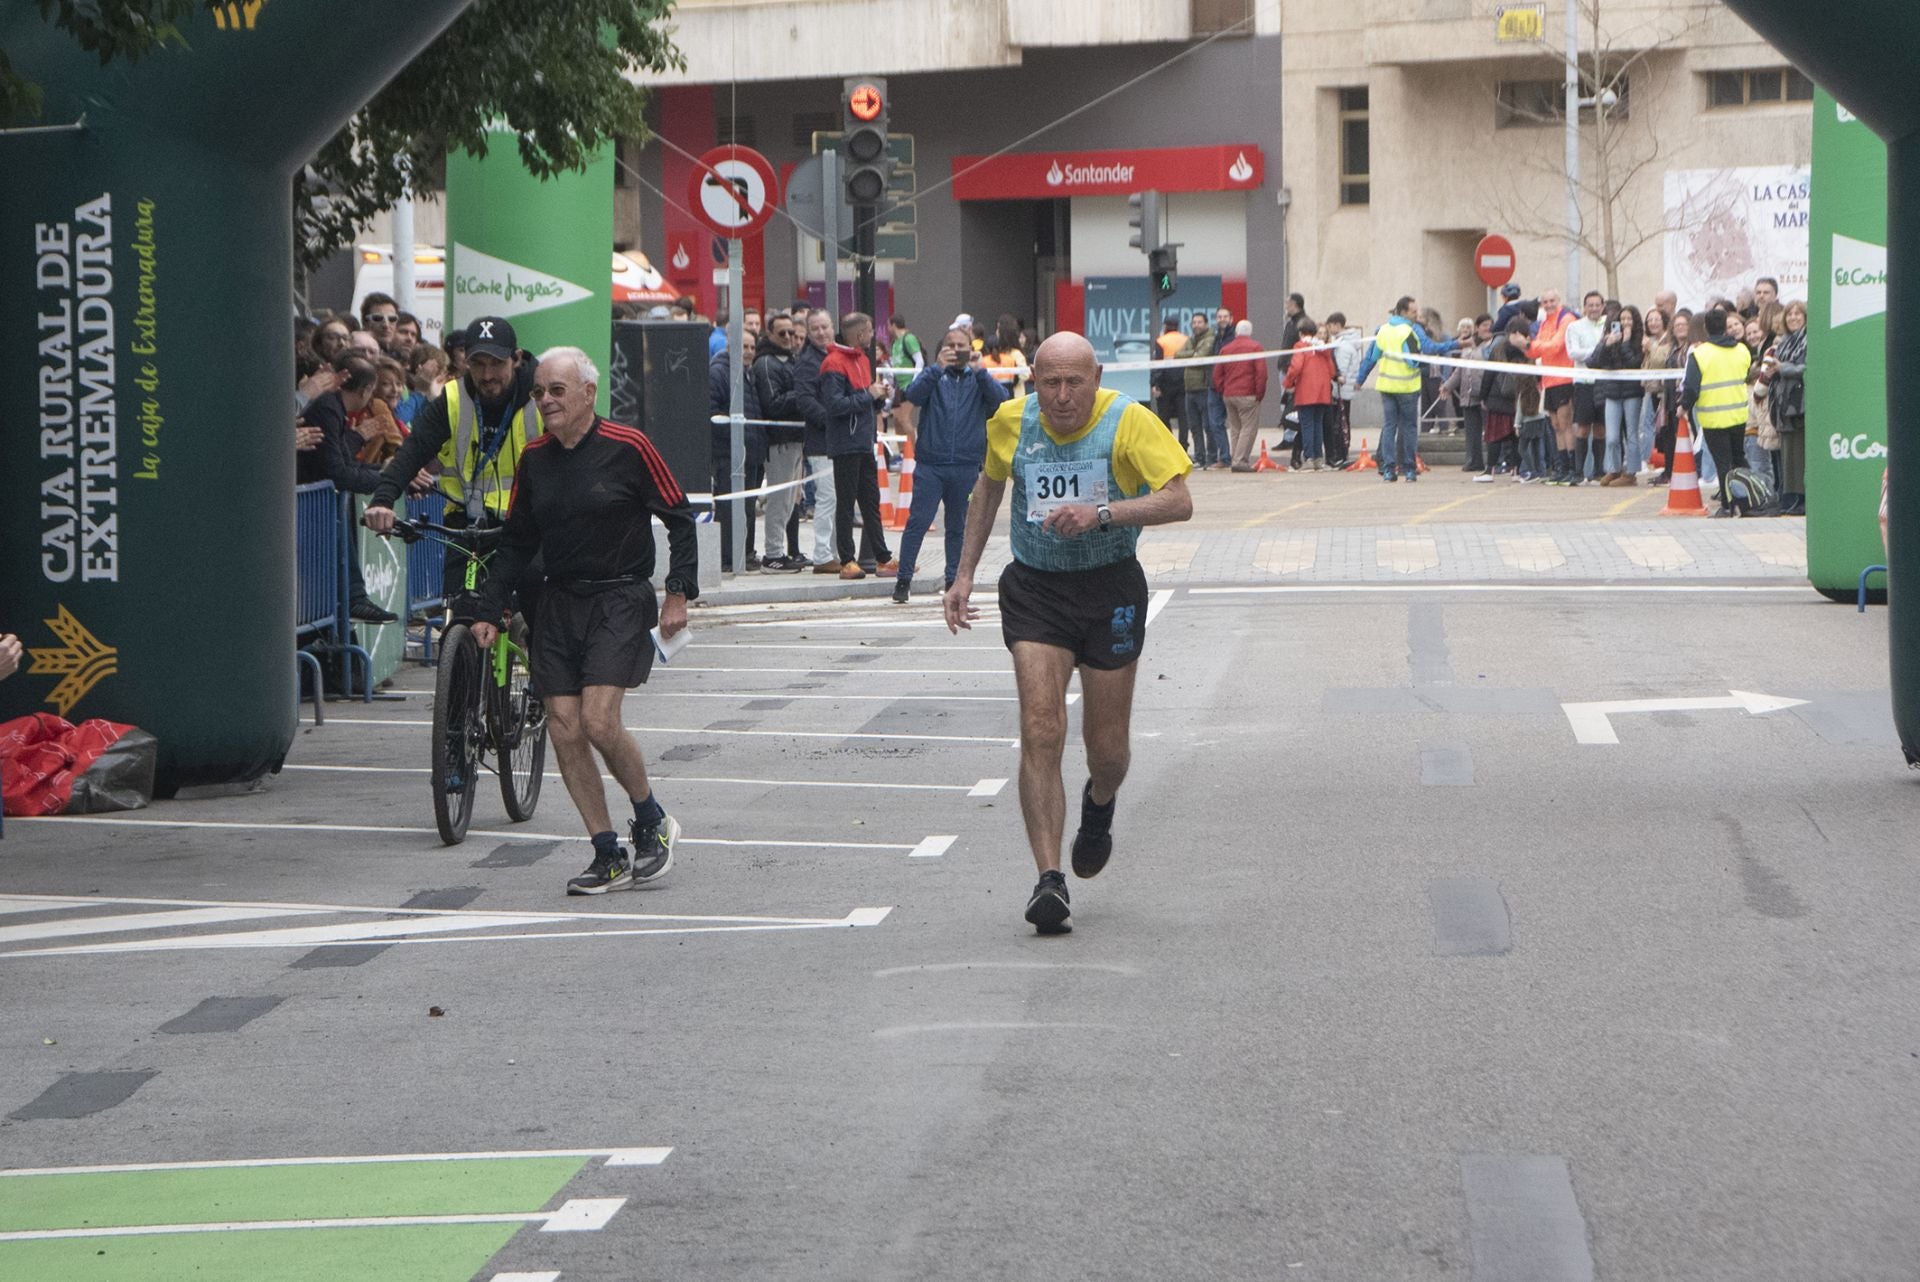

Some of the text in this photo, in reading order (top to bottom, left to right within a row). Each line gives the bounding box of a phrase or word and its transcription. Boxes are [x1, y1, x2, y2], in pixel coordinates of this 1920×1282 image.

[1065, 162, 1135, 185] Santander
[1754, 183, 1811, 201] LA CAS
[1773, 212, 1809, 228] MAP
[468, 276, 502, 295] Corte
[1780, 274, 1808, 283] BADA
[1835, 267, 1849, 286] El
[479, 321, 494, 339] X
[1088, 308, 1136, 337] MUY
[131, 197, 165, 479] La caja de Extremadura
[75, 192, 118, 582] EXTREMADURA
[35, 222, 79, 583] CAJA RURAL DE
[1829, 432, 1850, 459] El
[1037, 473, 1080, 500] 301
